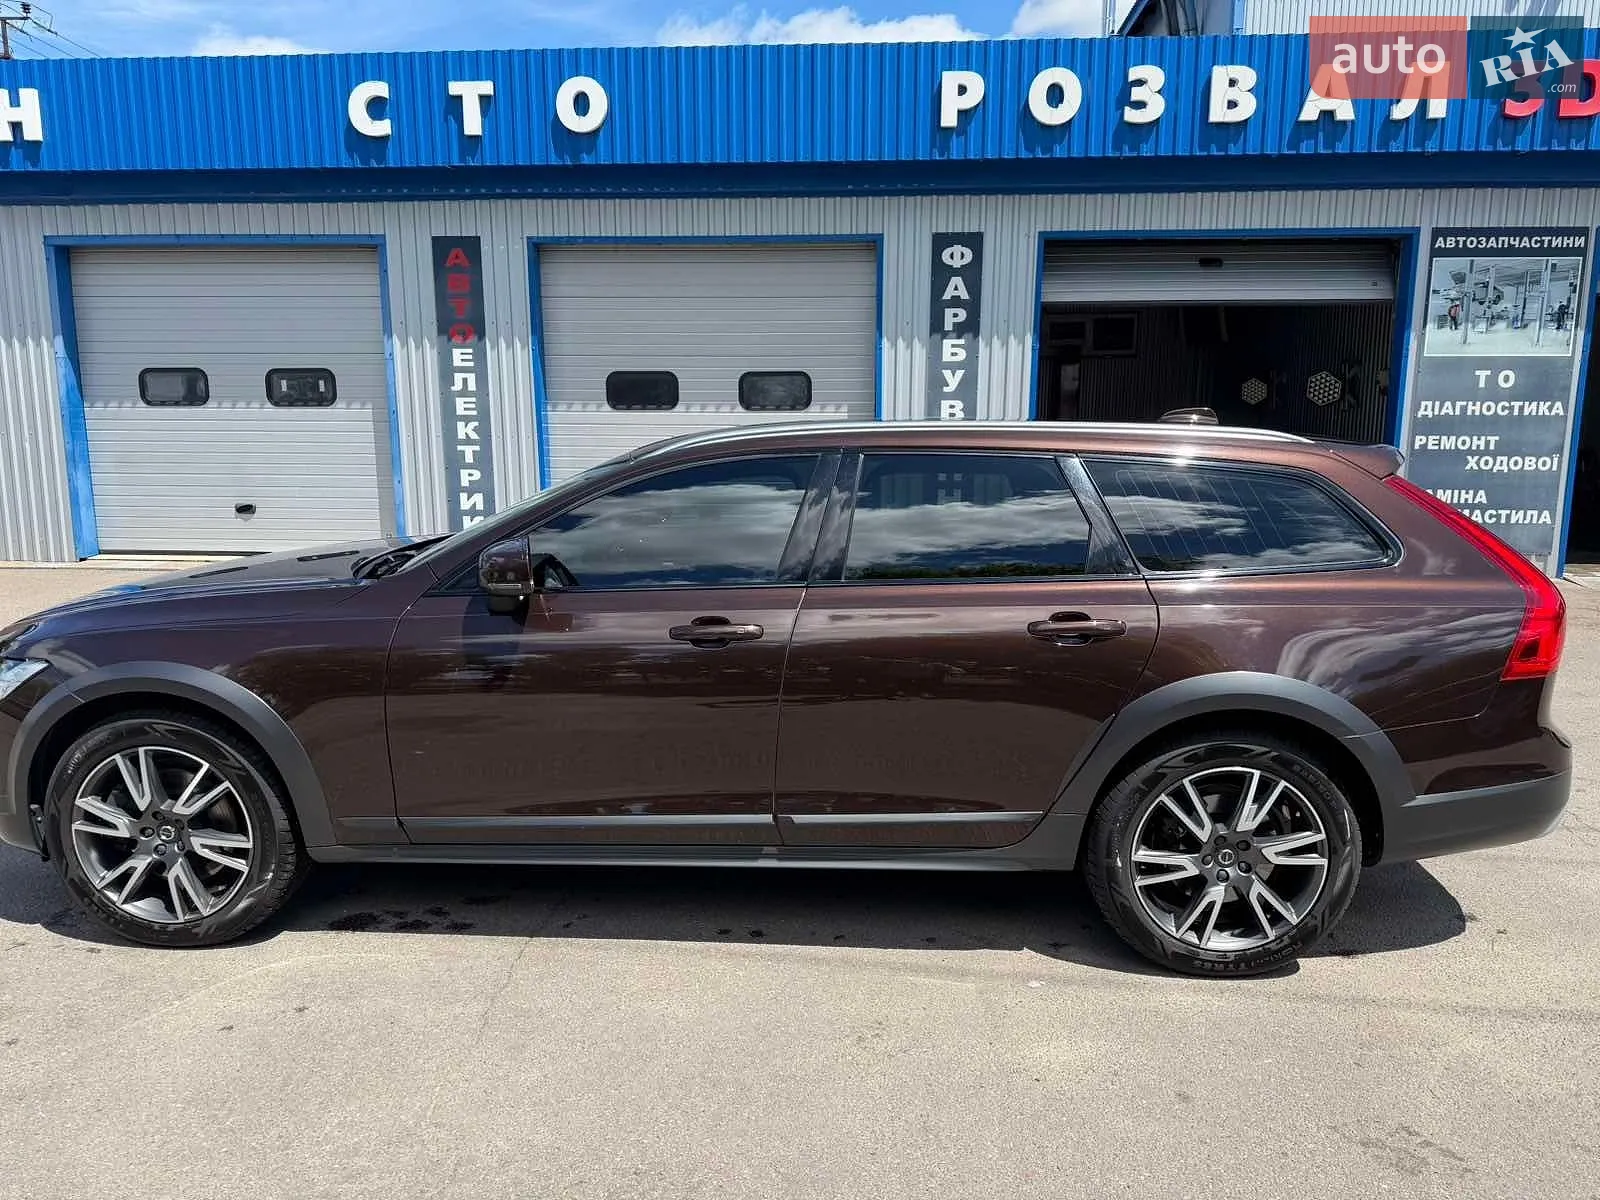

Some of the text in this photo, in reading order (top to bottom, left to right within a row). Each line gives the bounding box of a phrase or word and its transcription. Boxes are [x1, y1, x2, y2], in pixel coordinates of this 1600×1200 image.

[939, 61, 1450, 129] РОЗВАЛ
[348, 76, 608, 137] СТО
[1435, 235, 1585, 249] АВТОЗАПЧАСТИНИ
[1417, 400, 1564, 418] ДІАГНОСТИКА
[1414, 435, 1500, 450] РЕМОНТ
[1465, 454, 1560, 472] ХОДОВОЇ
[1425, 489, 1488, 504] МІНА
